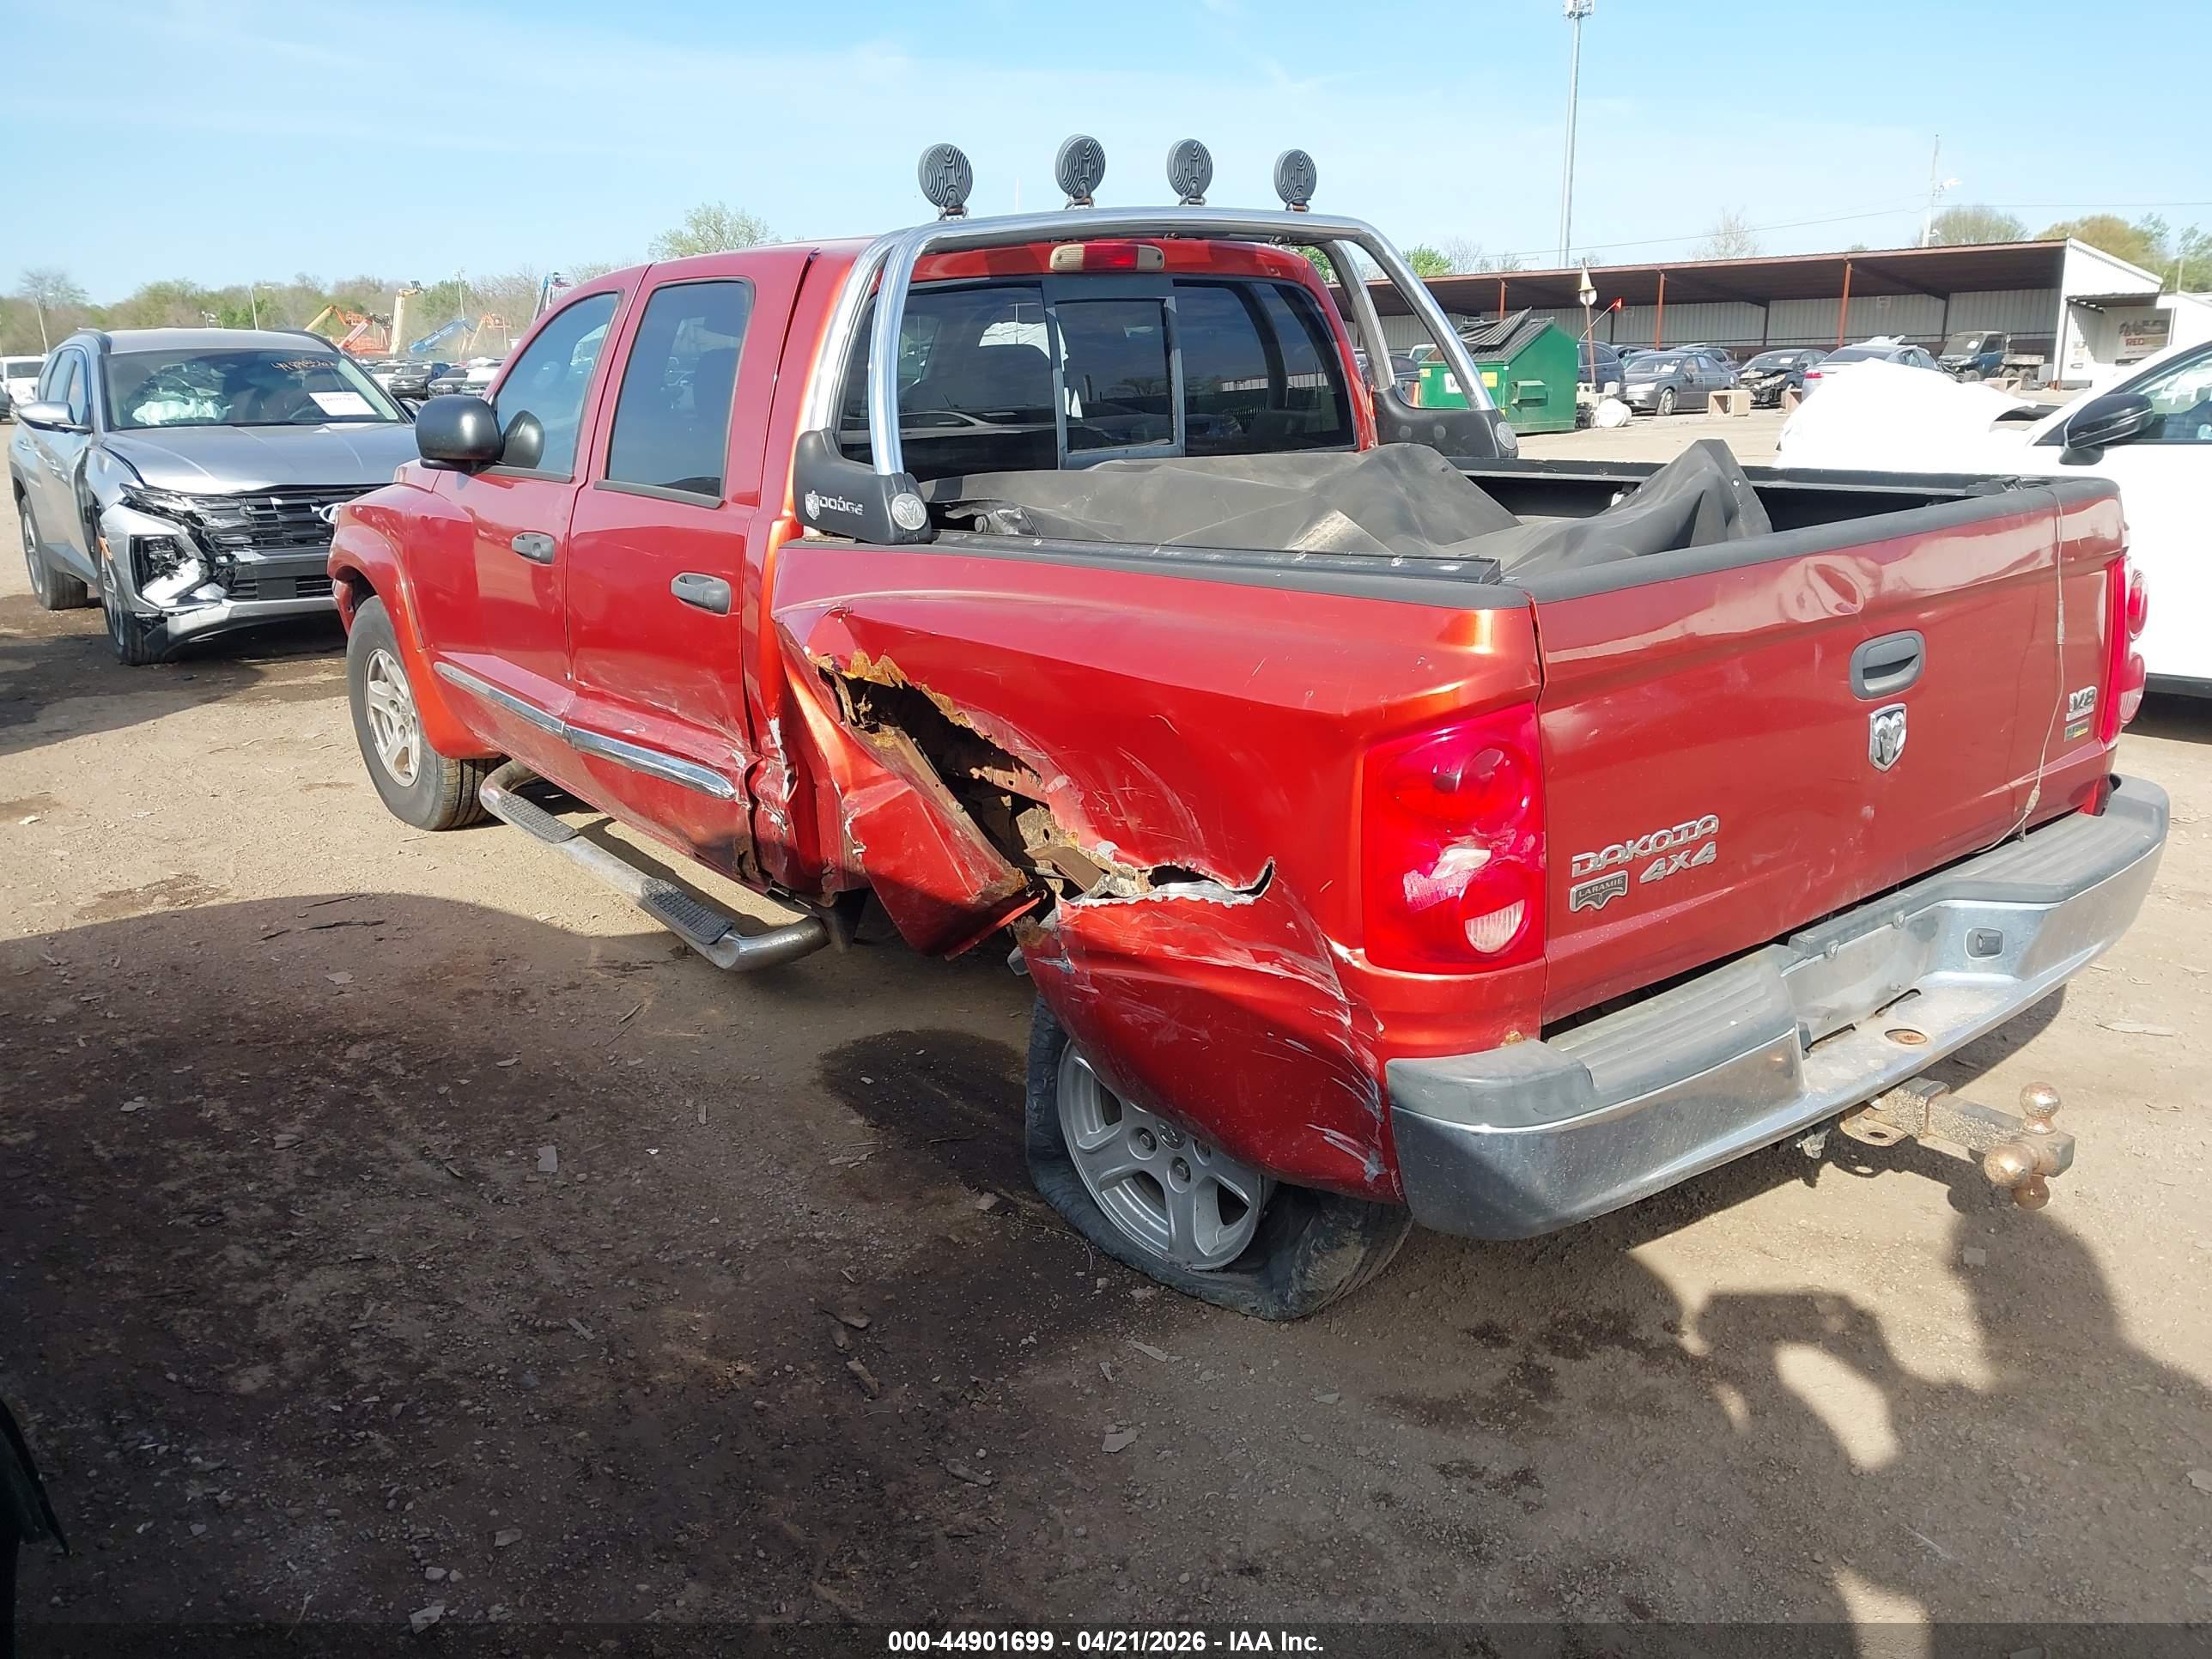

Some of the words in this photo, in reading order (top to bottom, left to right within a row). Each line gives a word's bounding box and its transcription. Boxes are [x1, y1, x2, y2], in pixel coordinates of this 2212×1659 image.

[819, 495, 865, 516] DODGE
[2069, 685, 2098, 712] V8
[1571, 814, 1720, 878] DAKOTA
[1578, 877, 1625, 898] LARAMIE
